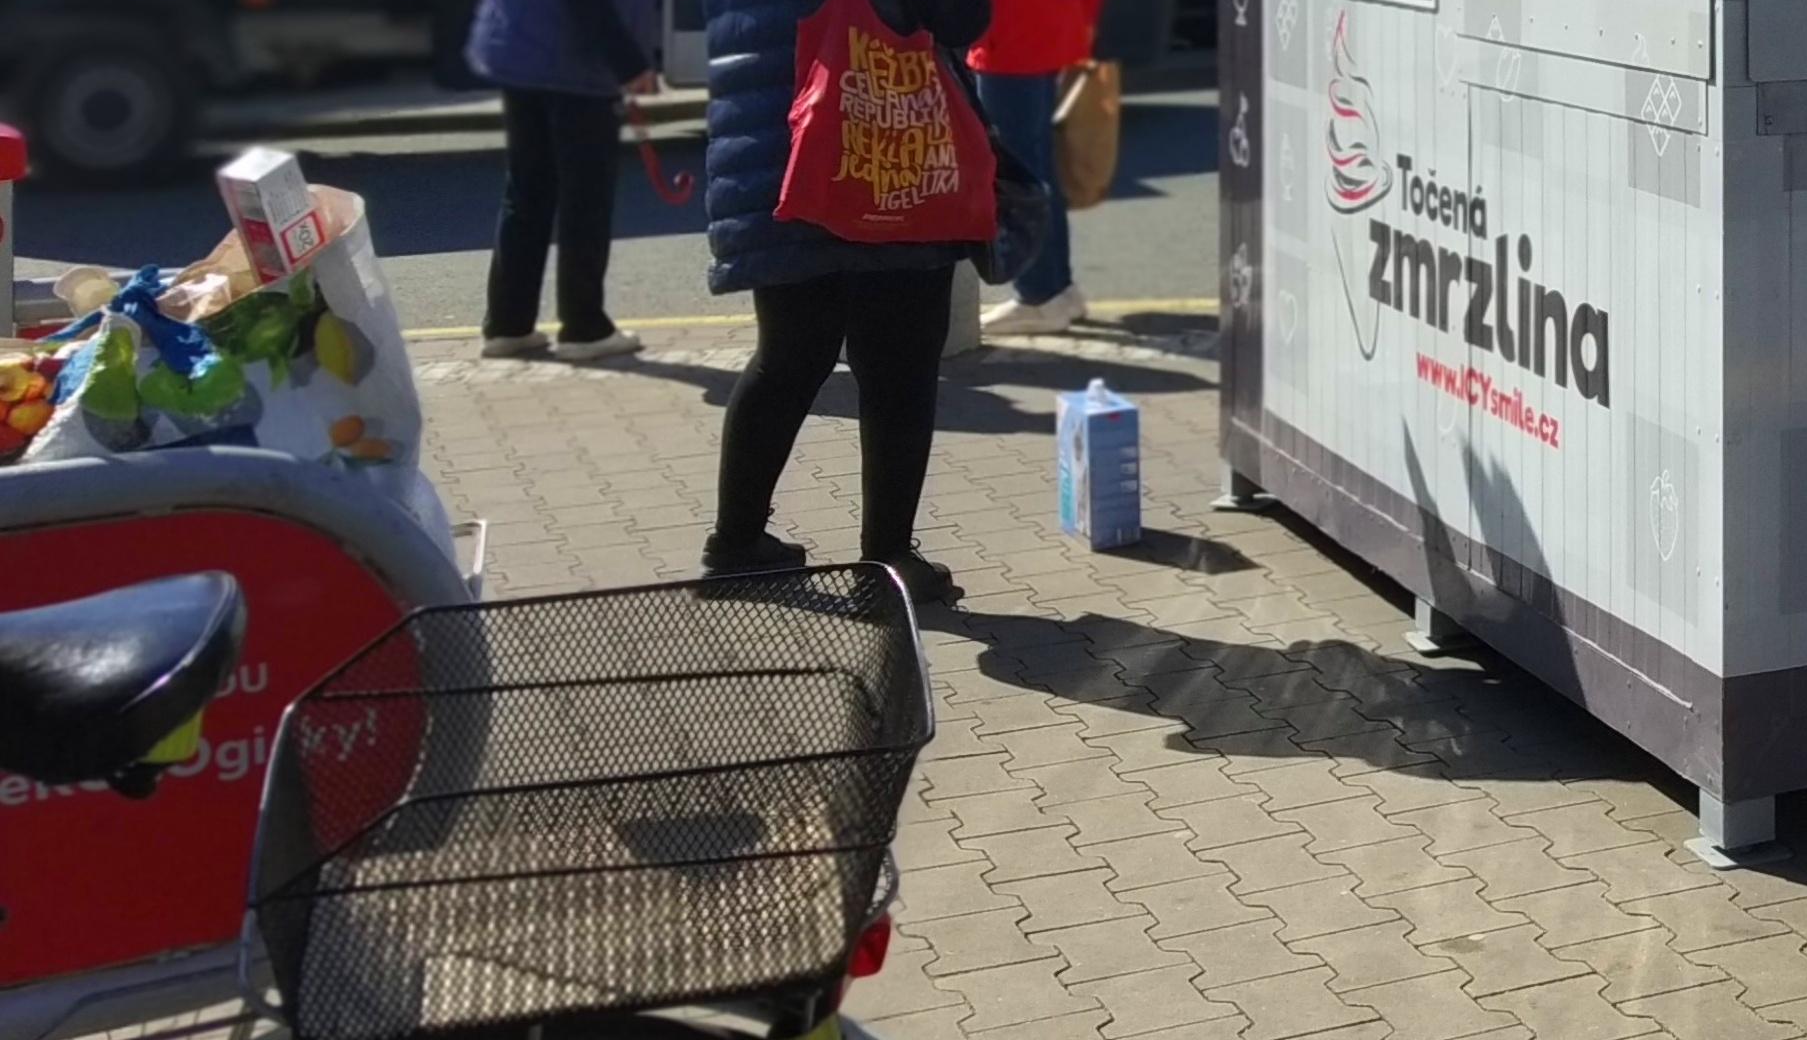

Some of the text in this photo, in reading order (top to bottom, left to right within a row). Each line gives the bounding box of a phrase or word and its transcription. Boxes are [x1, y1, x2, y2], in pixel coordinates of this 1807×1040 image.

[1397, 153, 1488, 240] Točená
[1369, 218, 1610, 410] zmrzlina
[1416, 351, 1560, 450] www.ICYsmile.cz
